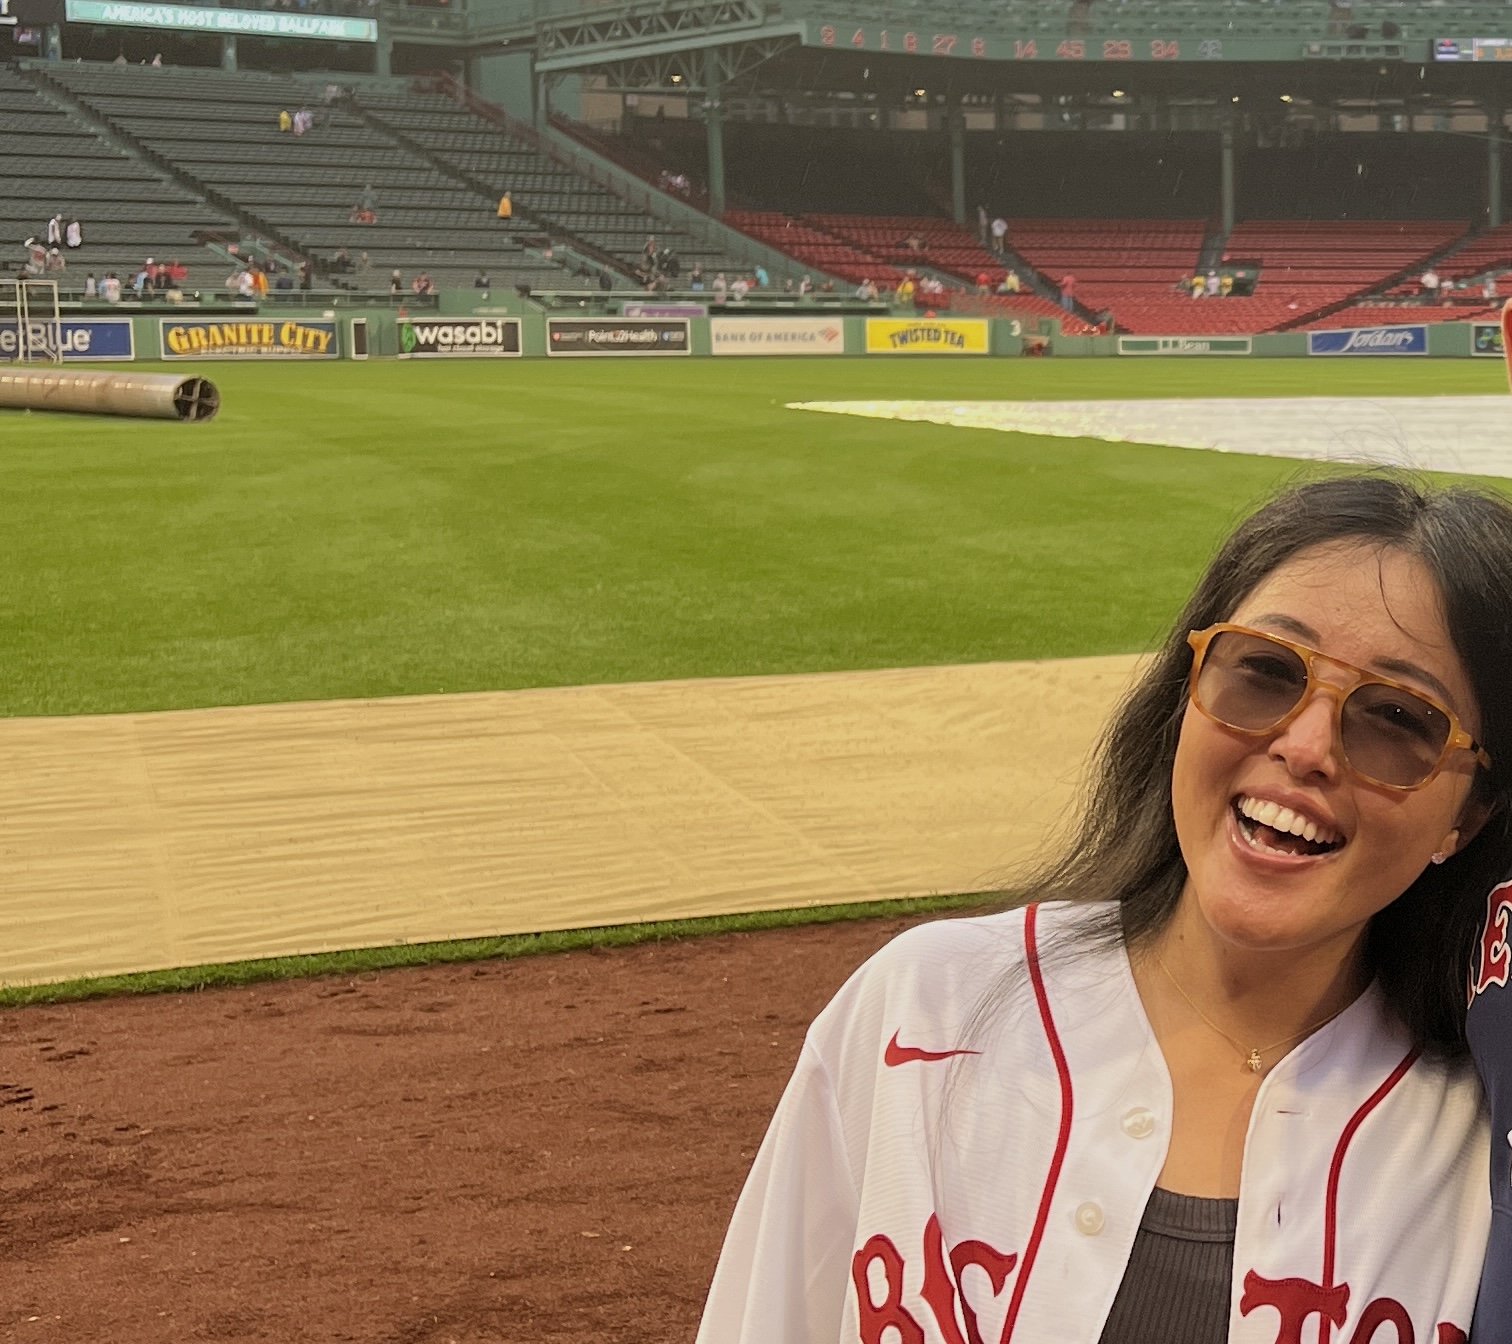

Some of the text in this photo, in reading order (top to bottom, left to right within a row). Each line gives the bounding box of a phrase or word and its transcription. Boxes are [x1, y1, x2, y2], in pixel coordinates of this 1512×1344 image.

[102, 4, 175, 26] AMERICA'S
[851, 28, 865, 48] 4
[880, 30, 889, 50] 1
[932, 33, 958, 55] 27
[1014, 39, 1038, 59] 14
[1056, 39, 1087, 59] 45
[167, 321, 333, 354] GRANITE CITY
[414, 319, 504, 345] wasabi
[715, 331, 816, 343] BANK OF AMERICA
[889, 327, 966, 349] TWISTED TEA
